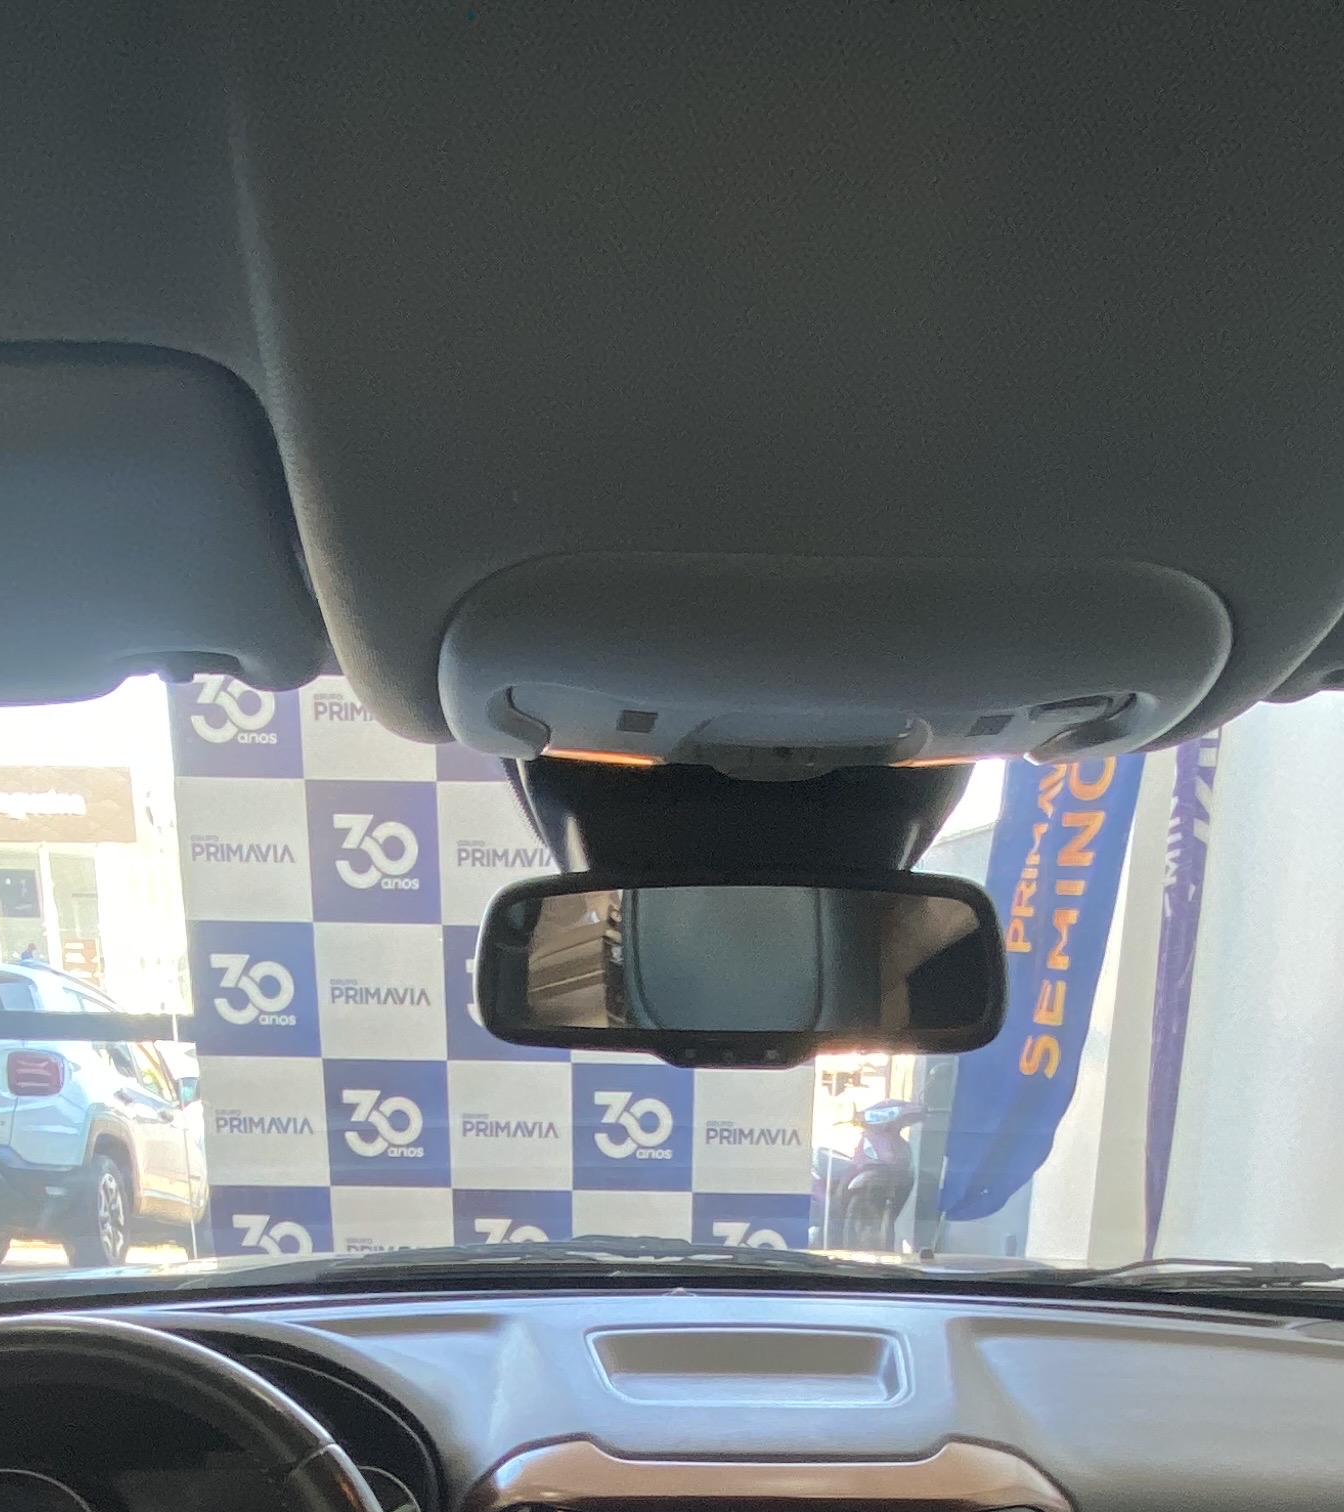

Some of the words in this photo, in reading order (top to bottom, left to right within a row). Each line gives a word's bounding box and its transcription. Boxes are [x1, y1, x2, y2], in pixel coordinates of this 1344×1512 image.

[313, 701, 374, 722] PRIM
[237, 731, 278, 744] anos
[191, 844, 296, 864] PRIMAVIA
[332, 813, 419, 890] 30
[381, 877, 419, 890] anos
[209, 953, 296, 1026] 30
[330, 987, 432, 1007] PRIMAVIA
[258, 1013, 297, 1027] anos
[215, 1117, 314, 1135] PRIMAVIA
[342, 1089, 424, 1158] 30
[462, 1120, 560, 1139] PRIMAVIA
[593, 1091, 674, 1159] 30
[705, 1128, 801, 1146] PRIMAVIA
[387, 1146, 425, 1158] anos
[636, 1148, 673, 1160] anos
